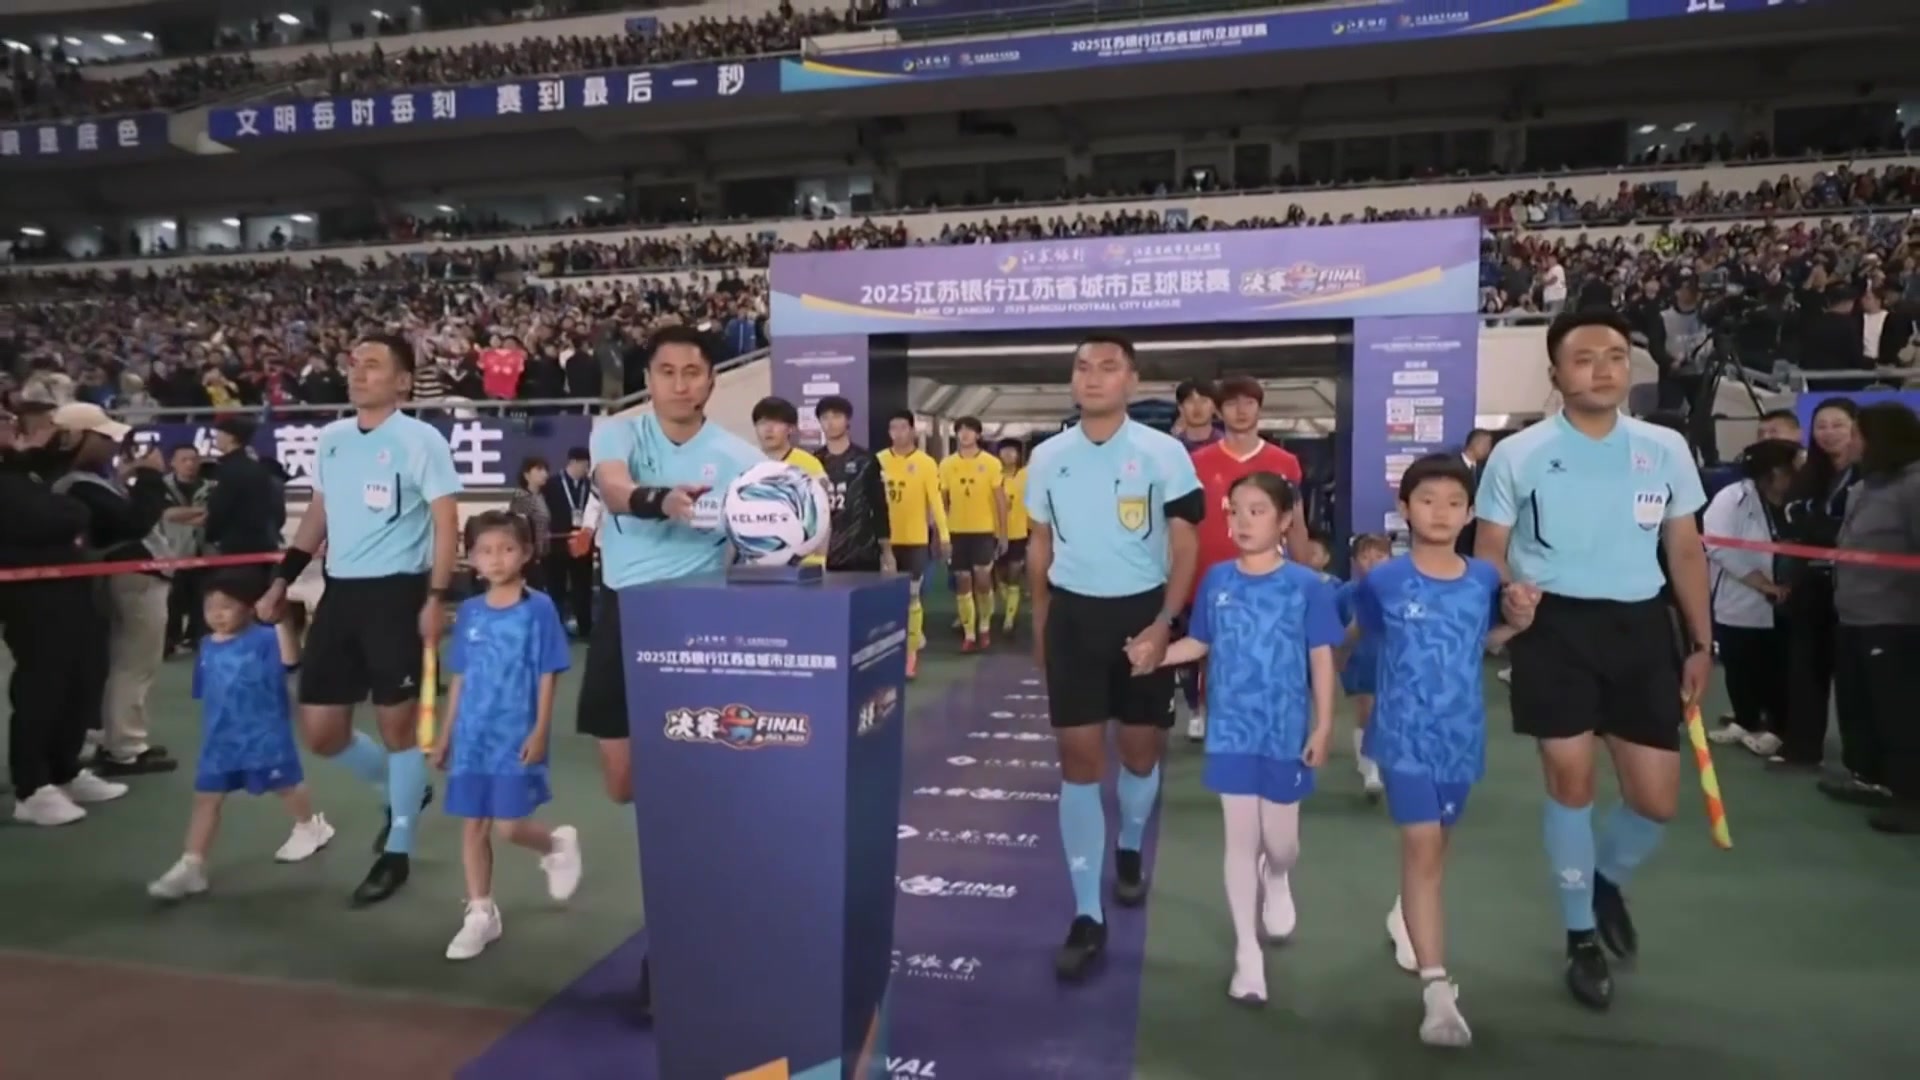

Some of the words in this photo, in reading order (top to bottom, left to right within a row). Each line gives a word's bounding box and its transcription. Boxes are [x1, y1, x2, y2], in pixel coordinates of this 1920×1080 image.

[235, 89, 457, 136] 文明每时每刻
[496, 63, 745, 114] 赛到最后一秒
[1318, 269, 1361, 282] FINAL
[861, 268, 1230, 304] 2025江苏银行江苏省城市足球联赛
[1068, 301, 1117, 312] FOOTBALL
[1637, 494, 1663, 504] FIFA
[731, 513, 778, 524] KELME
[667, 711, 721, 740] 决赛
[756, 716, 807, 733] FINAL
[950, 881, 1018, 898] FINAL
